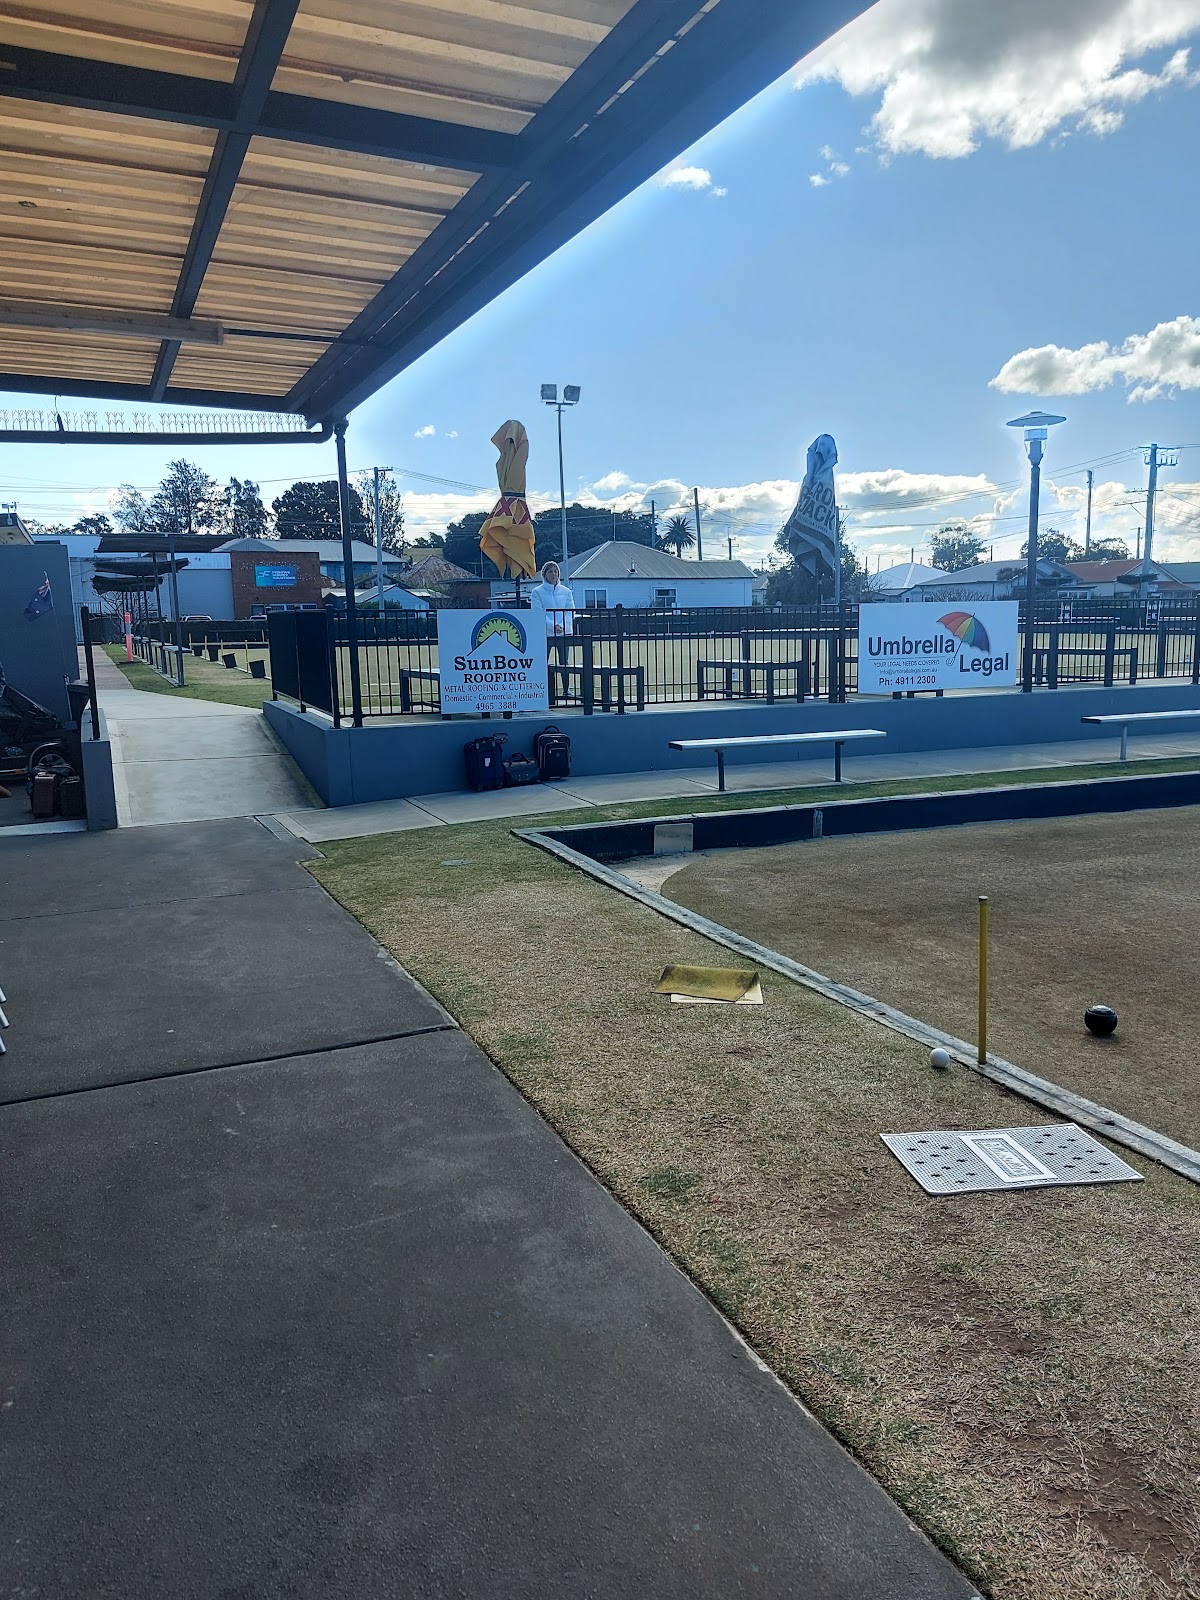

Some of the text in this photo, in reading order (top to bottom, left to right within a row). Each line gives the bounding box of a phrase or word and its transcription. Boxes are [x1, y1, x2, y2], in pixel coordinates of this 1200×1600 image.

[868, 634, 955, 656] Umbrella
[454, 655, 534, 671] SunBow
[959, 653, 1009, 677] Legal
[463, 672, 527, 684] ROOFING
[878, 675, 936, 686] Ph: 4911 2300
[444, 684, 466, 693] METAL
[468, 684, 499, 692] ROOFING
[508, 682, 545, 691] GUTTERING
[444, 694, 473, 702] Domestic
[478, 692, 513, 700] Commercial
[518, 691, 545, 699] Industrial
[475, 702, 494, 710] 4965
